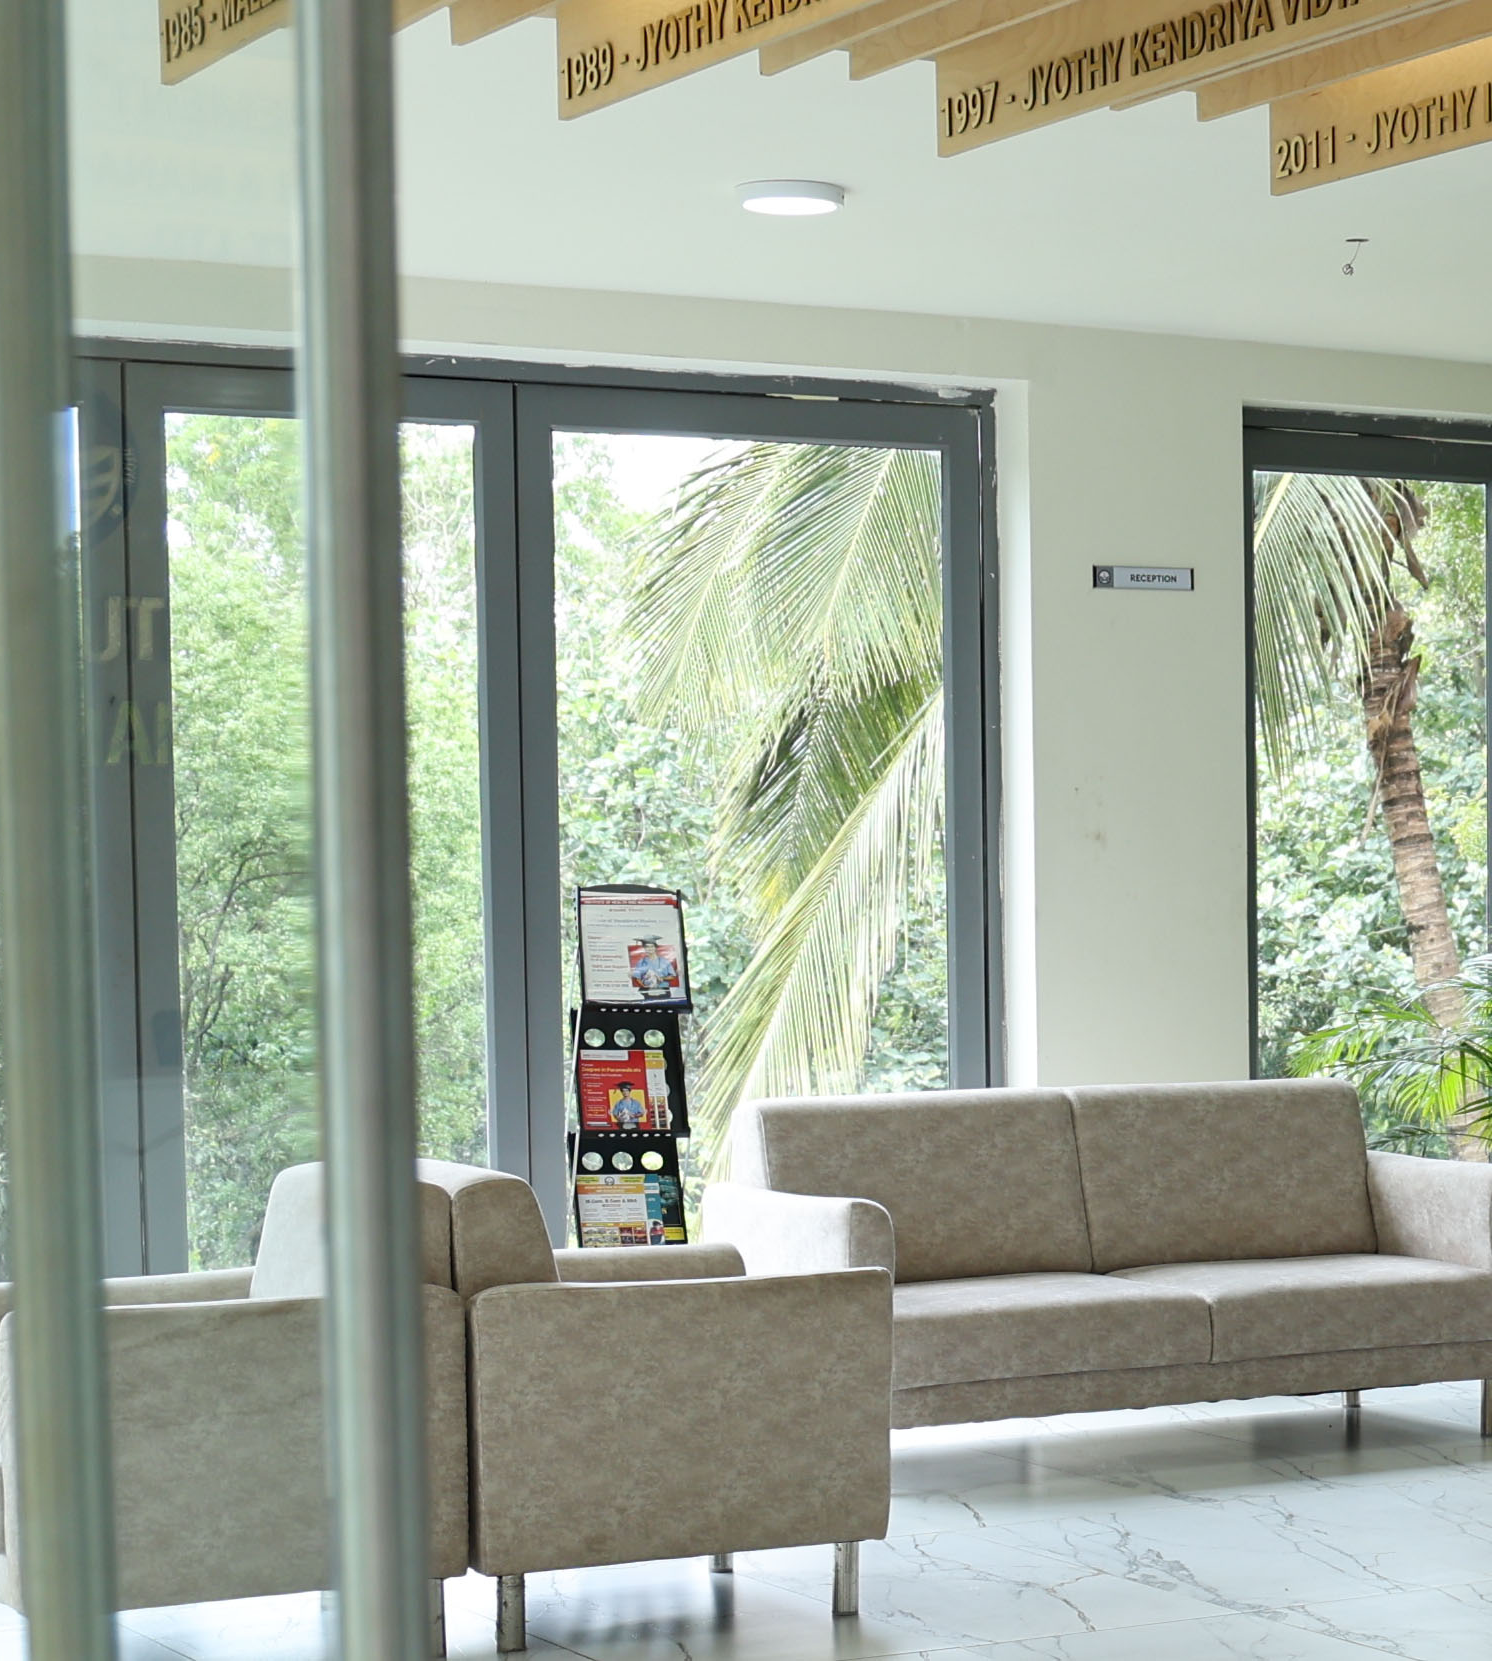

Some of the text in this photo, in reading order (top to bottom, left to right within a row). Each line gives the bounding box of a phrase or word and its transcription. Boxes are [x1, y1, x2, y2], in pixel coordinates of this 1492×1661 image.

[161, 0, 205, 62] 1985
[561, 41, 614, 100] 1989
[636, 0, 726, 71] JYOTHY
[941, 0, 1275, 137] 1997 JYOTHY KENDRIYA
[1276, 126, 1337, 179] 2011
[1365, 86, 1477, 154] JYOTHY
[1130, 574, 1177, 583] RECEPTION
